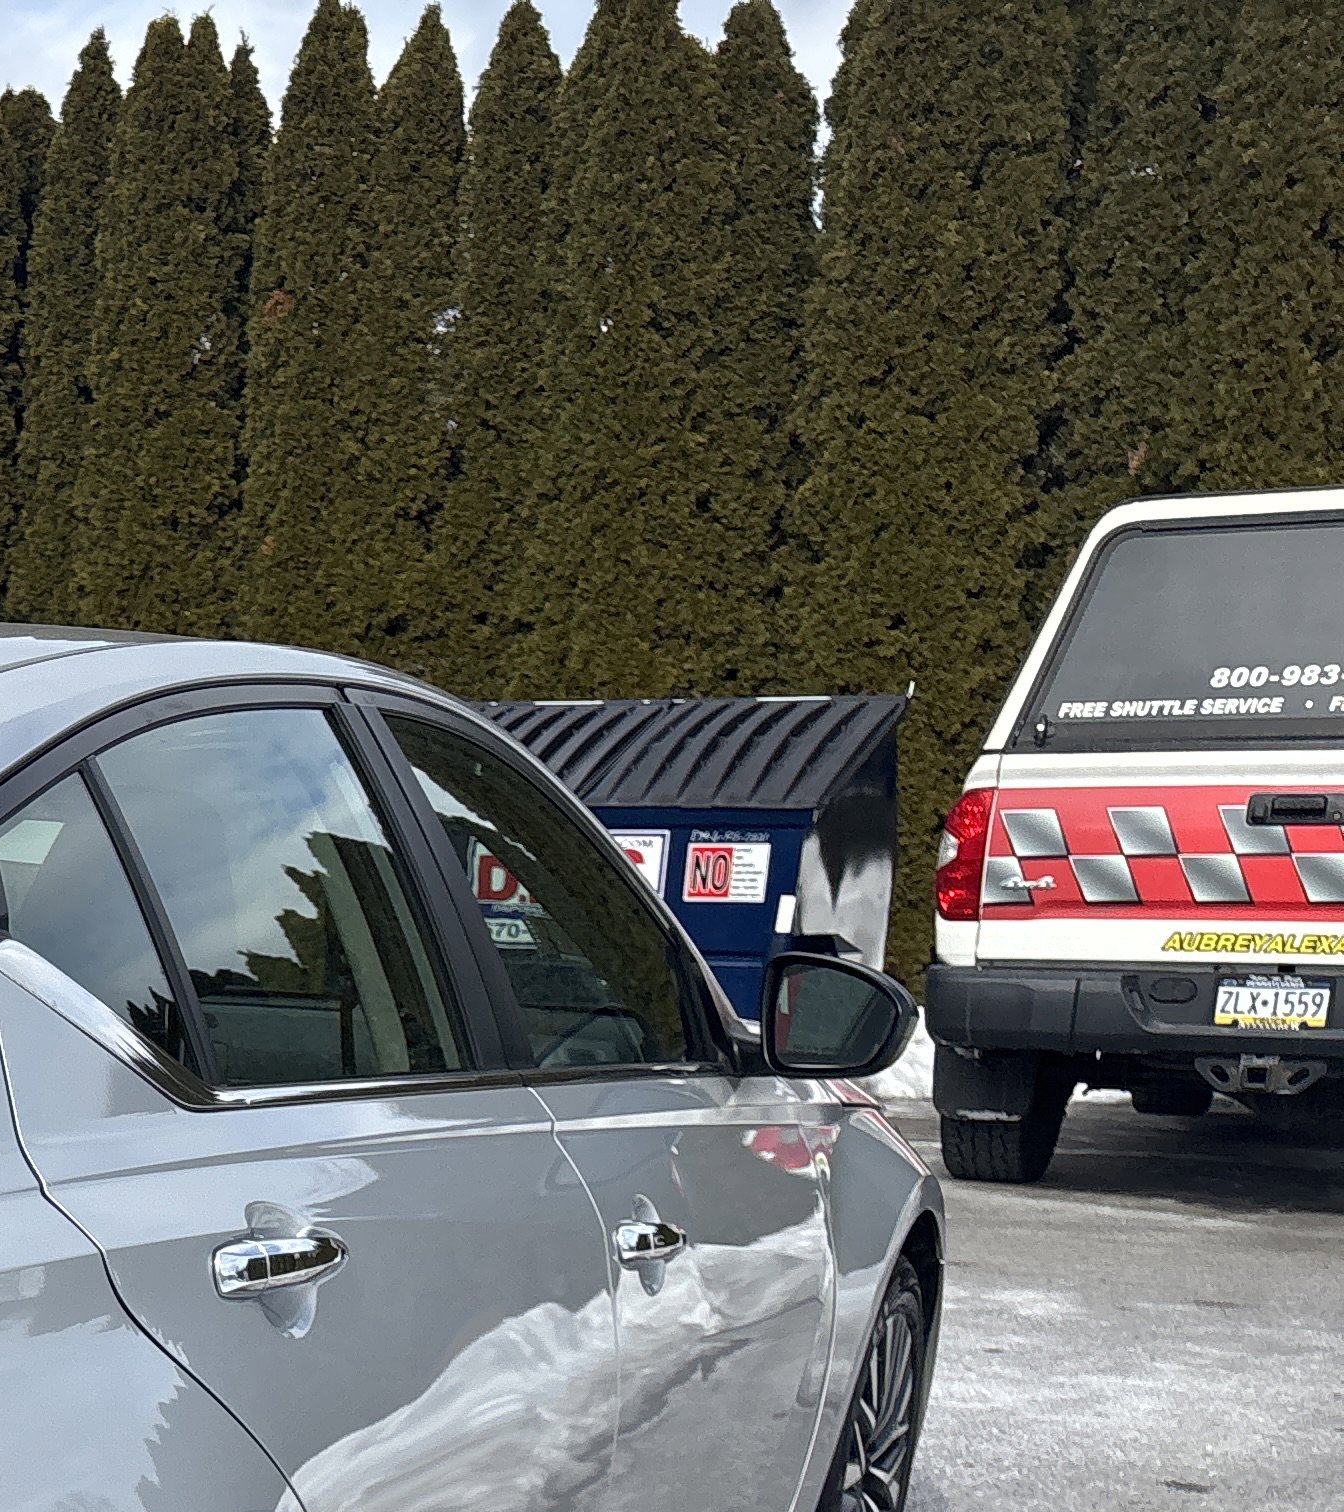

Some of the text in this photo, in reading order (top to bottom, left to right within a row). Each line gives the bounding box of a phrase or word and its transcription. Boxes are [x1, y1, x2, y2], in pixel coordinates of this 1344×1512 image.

[1058, 702, 1109, 719] FREE
[1110, 700, 1199, 717] SHUTTLE
[1200, 697, 1285, 715] SERVICE
[690, 852, 729, 891] NO
